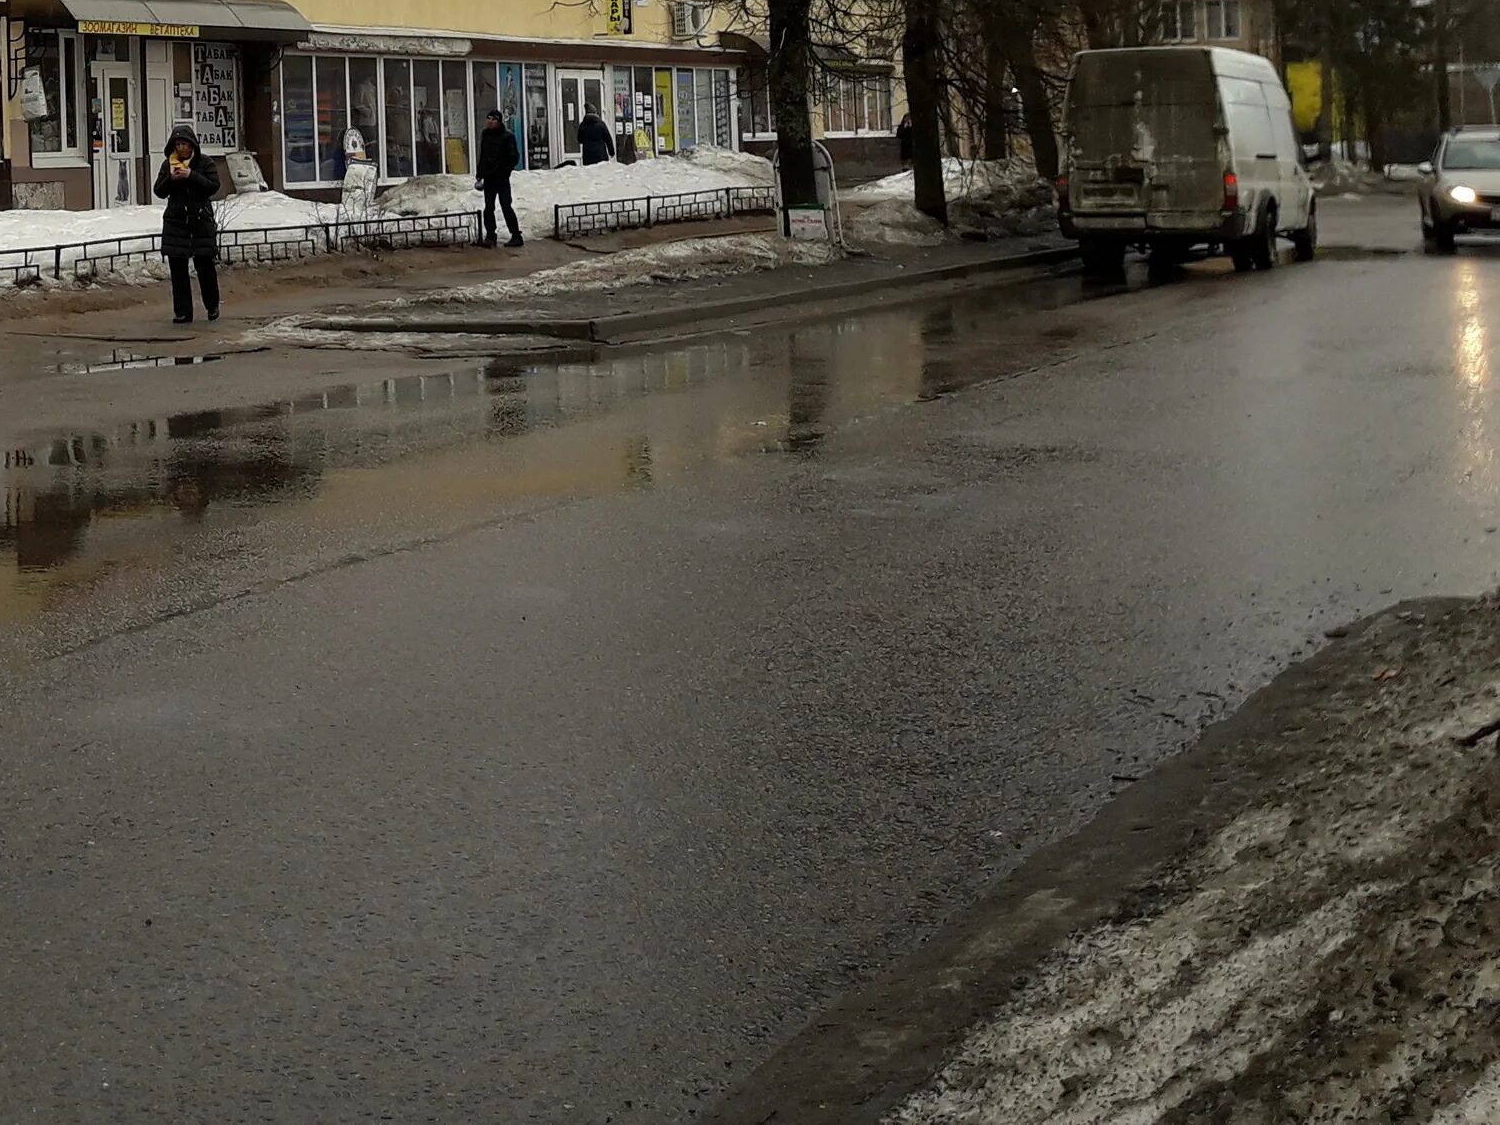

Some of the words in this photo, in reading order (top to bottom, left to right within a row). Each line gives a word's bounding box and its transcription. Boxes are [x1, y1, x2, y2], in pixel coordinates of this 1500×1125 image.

[82, 20, 138, 34] ЗООМАГАЗИН
[149, 24, 195, 37] ВЕТАПТЕКА
[194, 66, 234, 84] ТАБАК
[195, 87, 234, 105] ТАБАК
[195, 108, 235, 126] ТАБАК
[197, 129, 236, 147] ТАБАК
